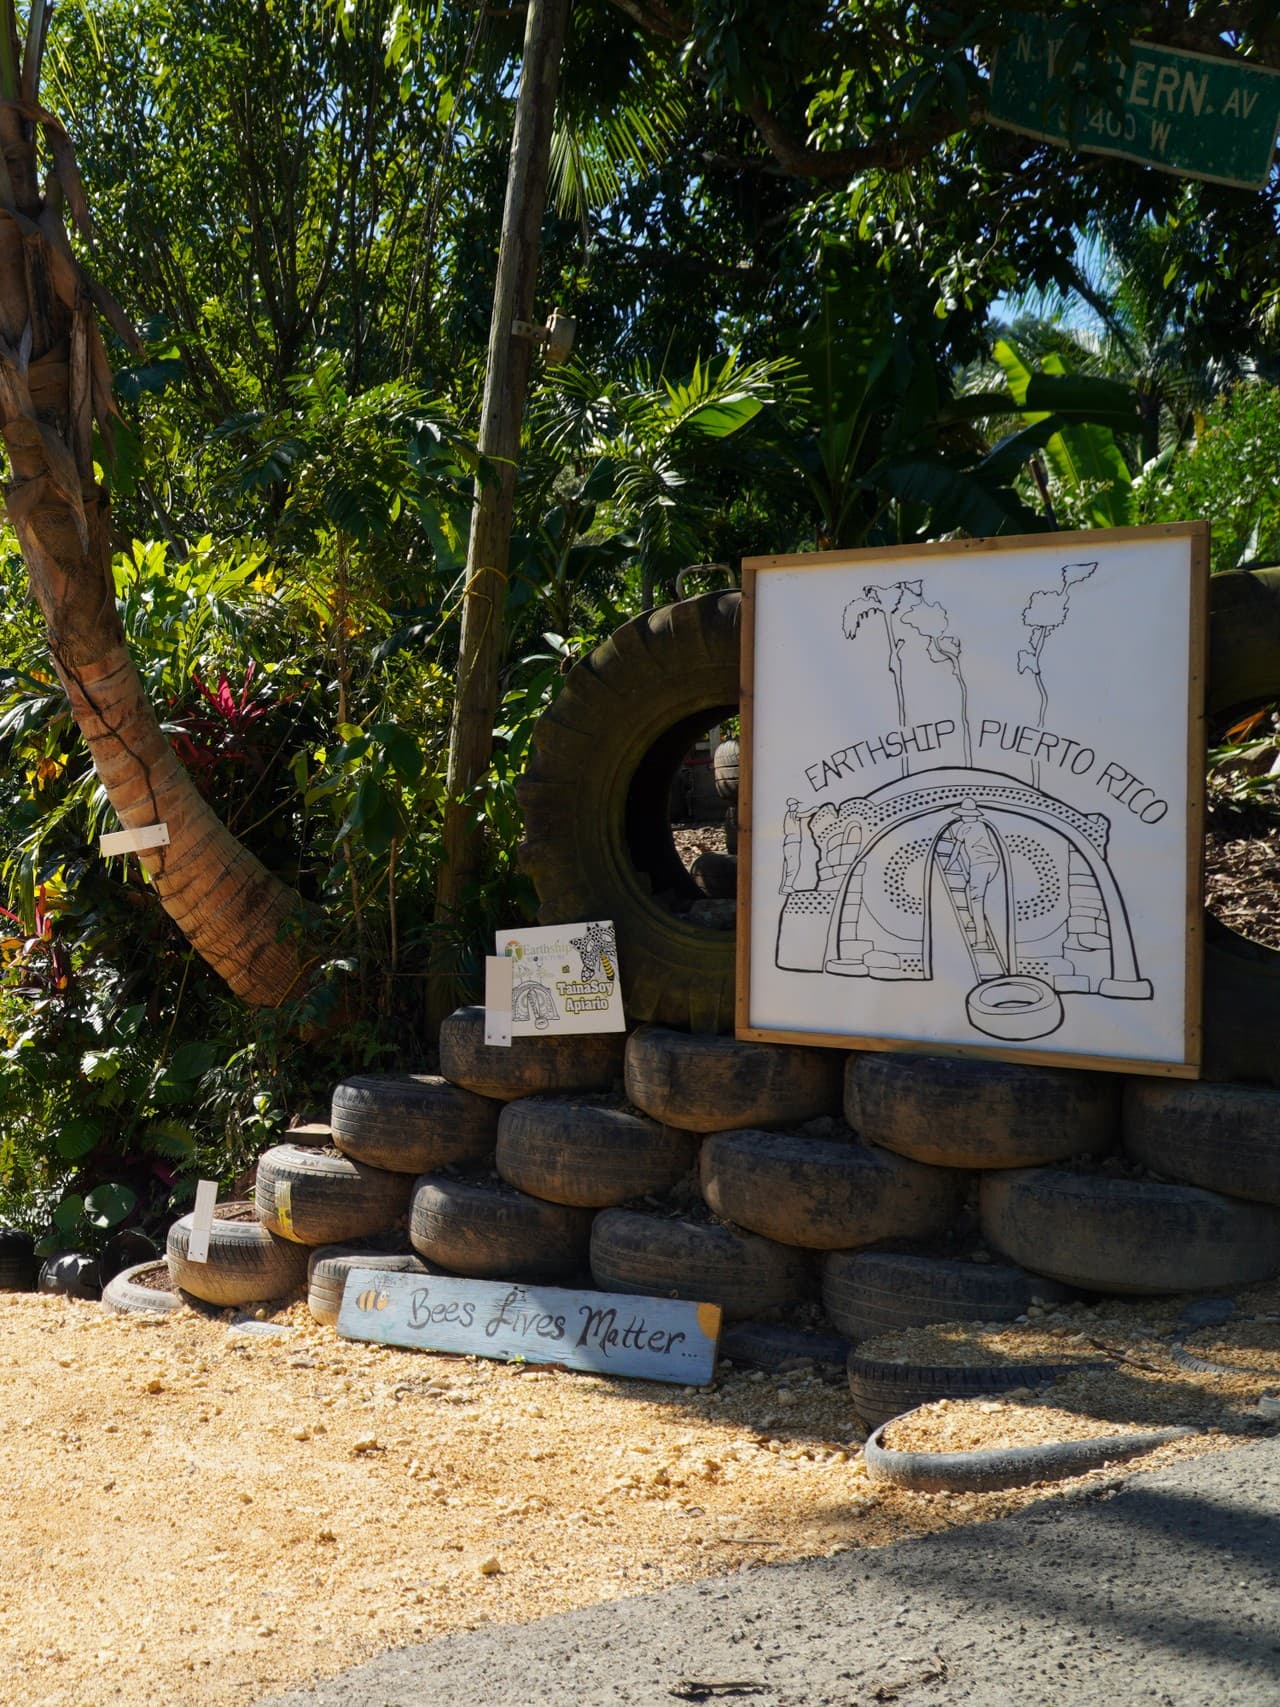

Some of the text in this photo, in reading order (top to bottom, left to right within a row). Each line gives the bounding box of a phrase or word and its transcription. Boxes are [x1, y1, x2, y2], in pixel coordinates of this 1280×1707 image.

[1149, 120, 1171, 154] W
[804, 719, 1169, 825] EARTHSHIP PUERTO RICO
[565, 996, 609, 1014] Apiario
[407, 1287, 476, 1330] Bees
[486, 1290, 566, 1341] Lives
